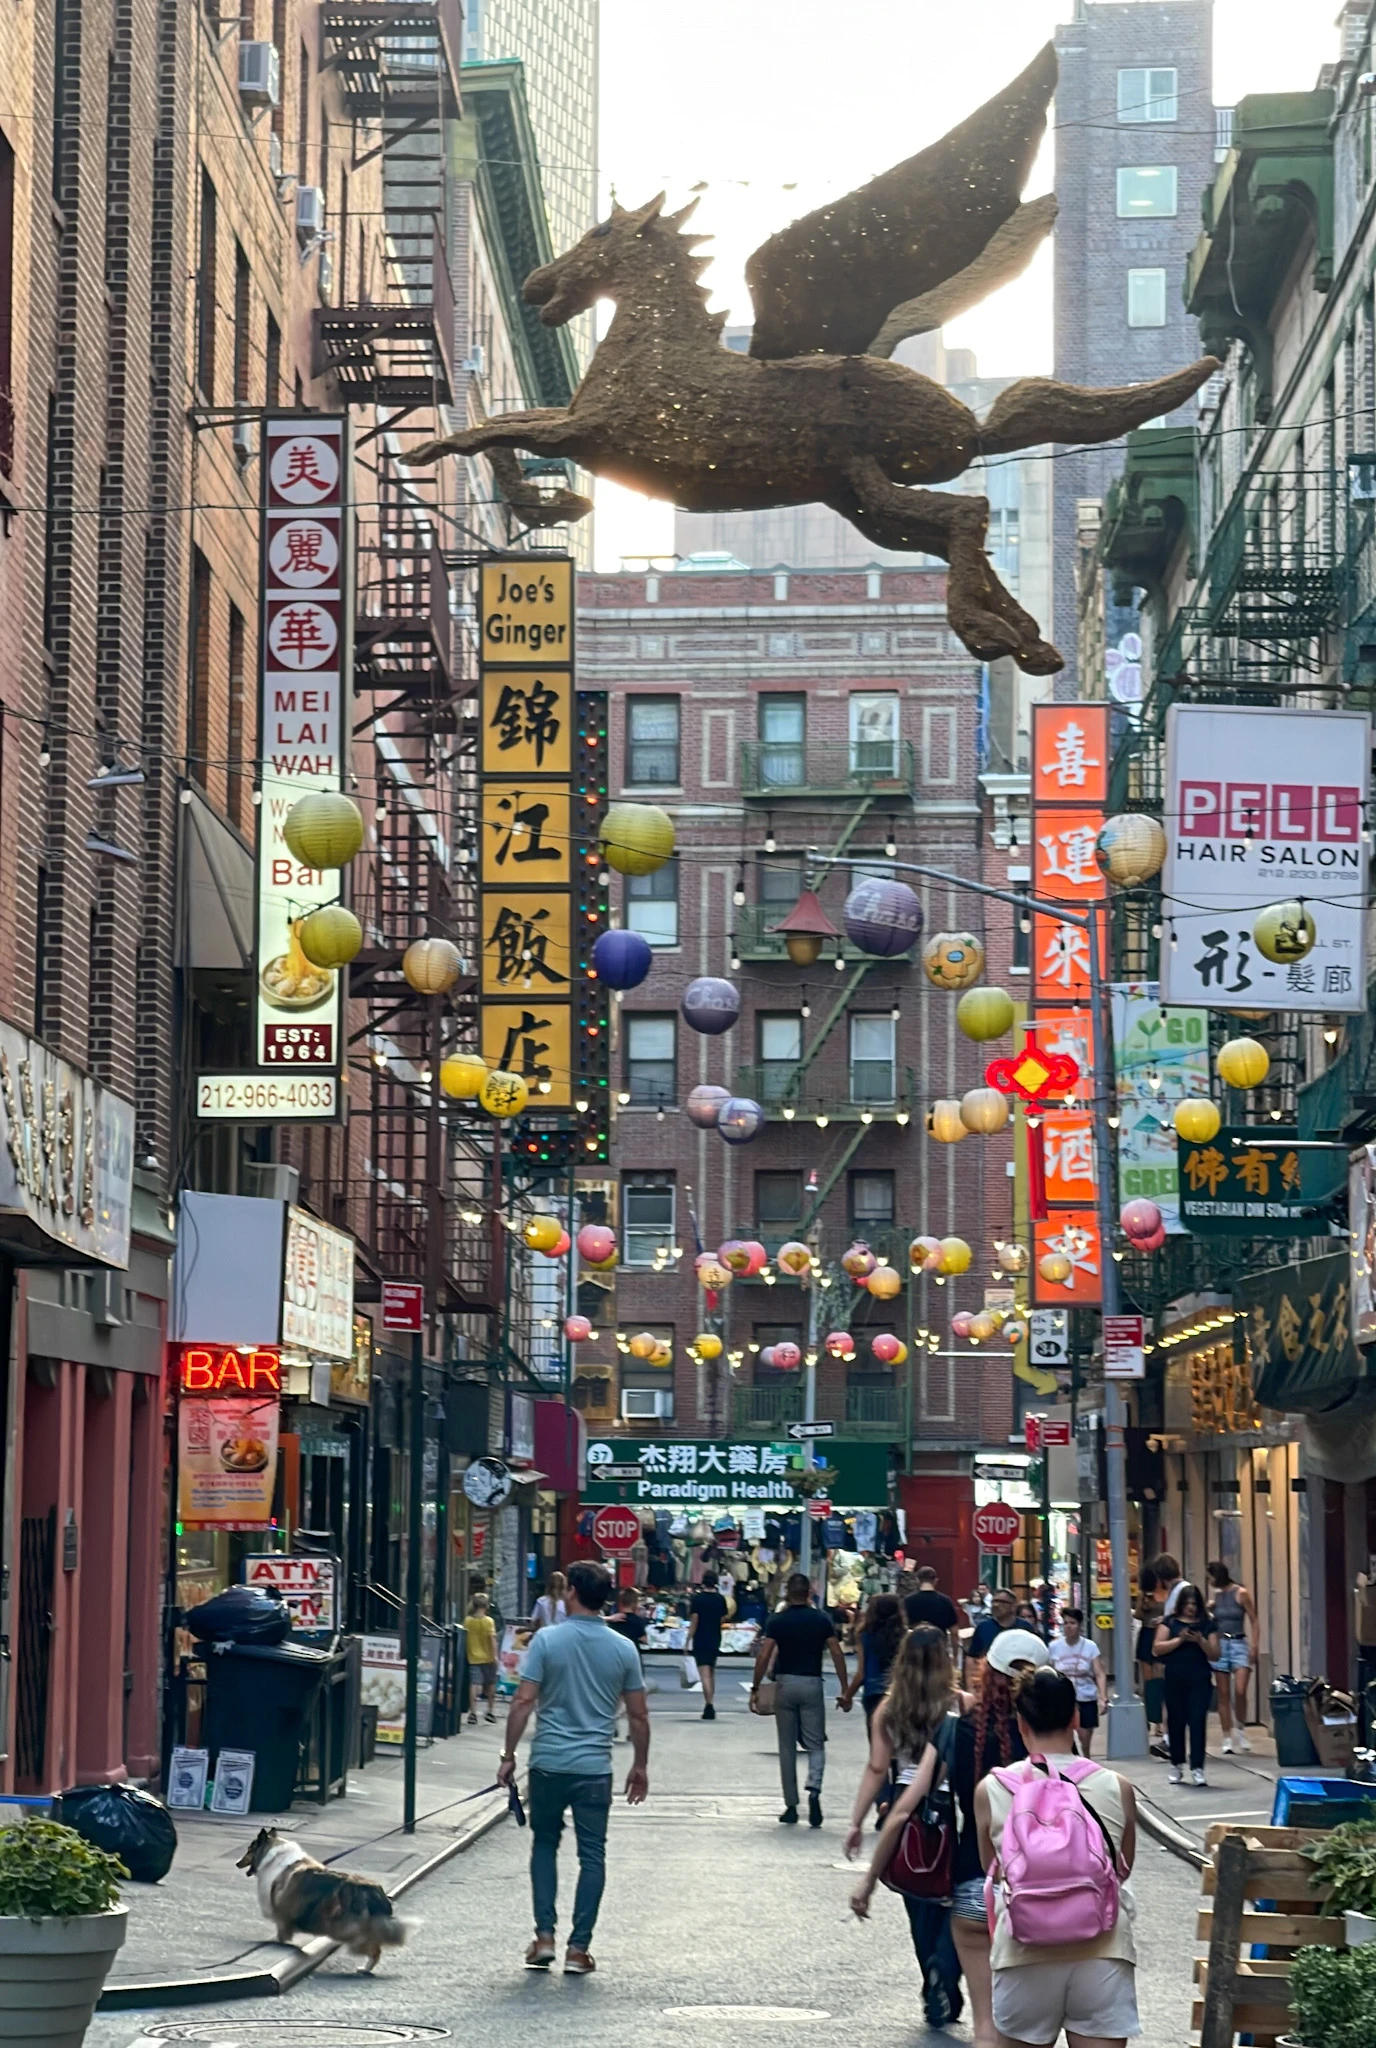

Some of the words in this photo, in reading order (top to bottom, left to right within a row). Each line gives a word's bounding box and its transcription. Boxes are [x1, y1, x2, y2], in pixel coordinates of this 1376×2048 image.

[277, 446, 331, 665] 美麗華
[497, 574, 555, 603] Joe's
[485, 613, 567, 651] Ginger
[274, 690, 331, 713] MEI
[277, 722, 328, 744] LAI
[272, 754, 333, 775] WAH
[1183, 787, 1352, 836] PELL
[1177, 842, 1246, 862] HAIR
[1260, 845, 1359, 868] SALON
[485, 680, 568, 1096] 錦江飯店
[275, 1028, 321, 1043] EST:
[1166, 1017, 1202, 1044] GO
[267, 1044, 326, 1060] 1964
[201, 1083, 332, 1108] 212-966-4033
[1183, 1200, 1245, 1217] VEGETARIAN
[1245, 1202, 1266, 1218] DIM
[183, 1351, 281, 1390] BAR
[591, 1450, 609, 1462] 37
[637, 1443, 789, 1475] 杰翔大藥房
[637, 1479, 728, 1502] Paradigm
[731, 1480, 794, 1498] Health
[596, 1520, 638, 1539] STOP
[976, 1515, 1018, 1535] STOP
